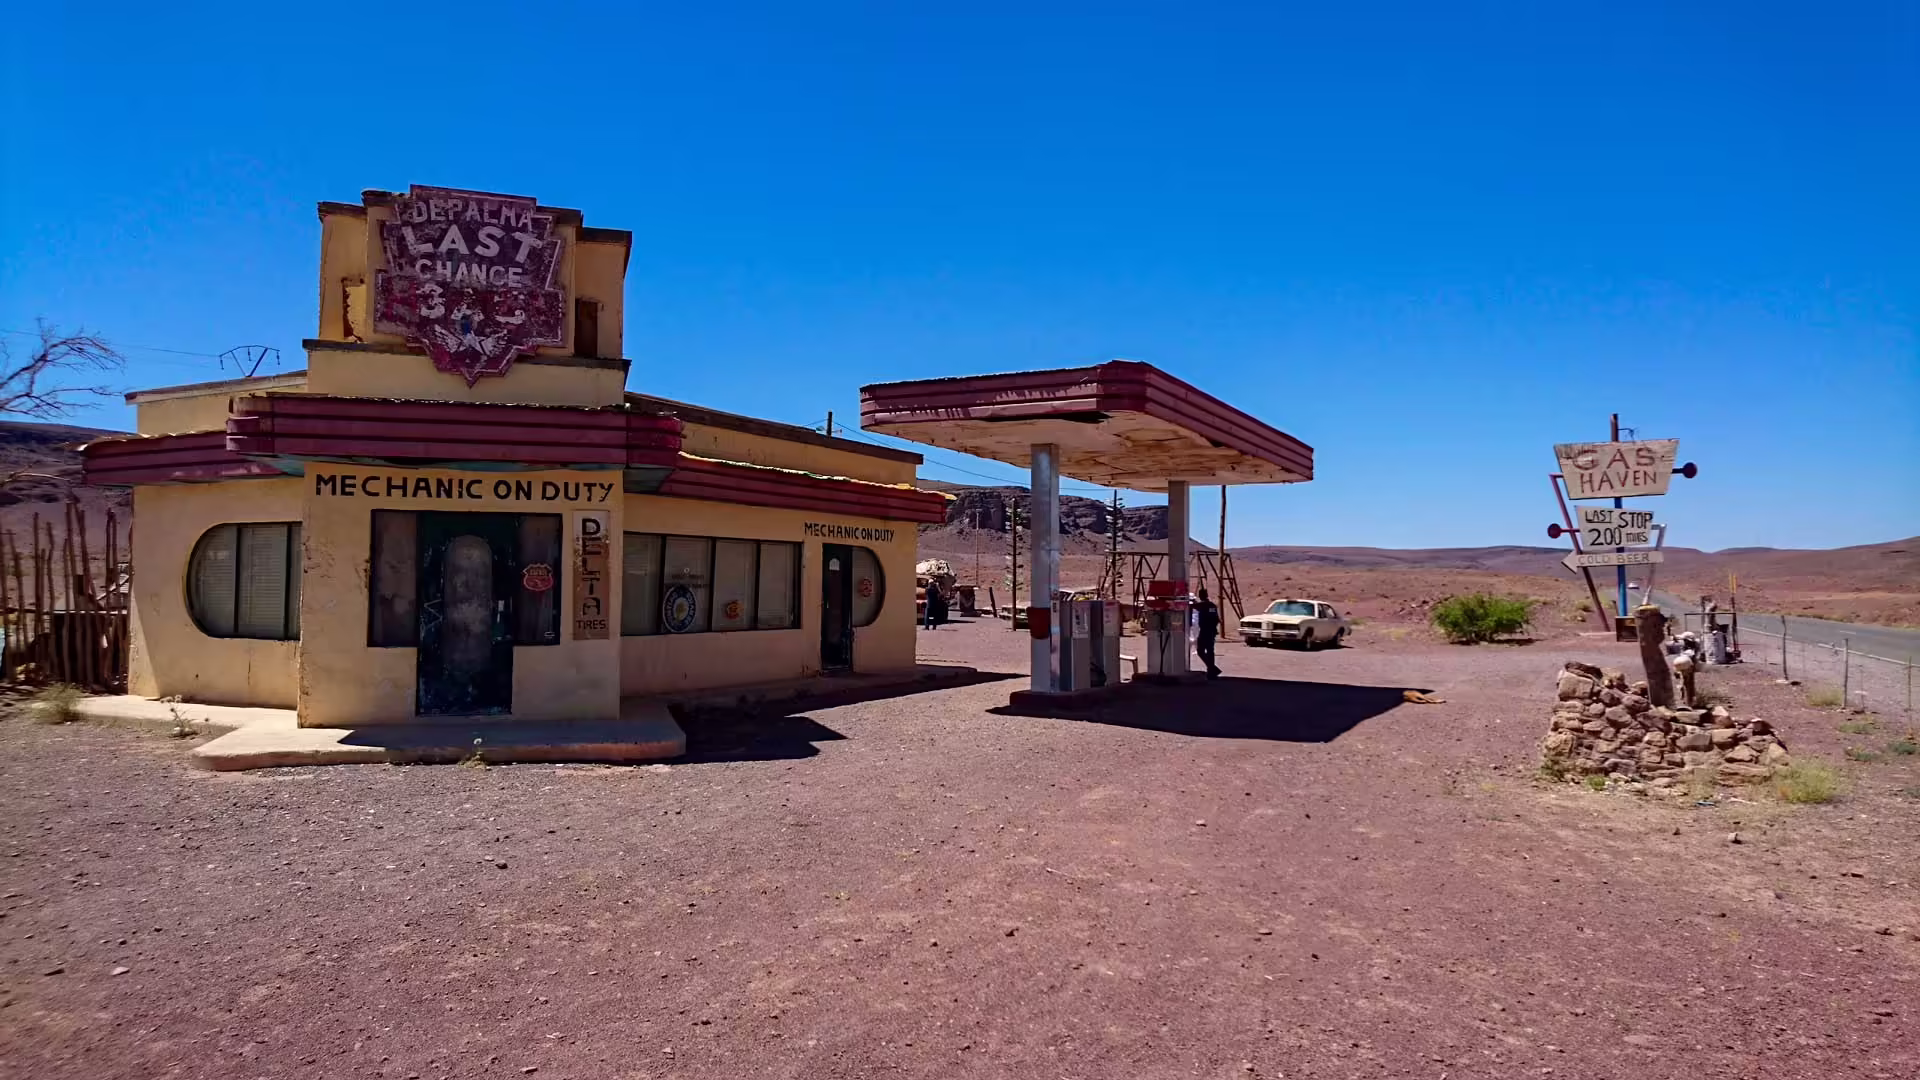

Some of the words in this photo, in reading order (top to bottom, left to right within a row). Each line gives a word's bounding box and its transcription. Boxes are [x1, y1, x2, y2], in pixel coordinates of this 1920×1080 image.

[412, 199, 534, 231] DEPALMA
[402, 224, 543, 263] LAST
[415, 258, 523, 288] CHANCE
[1573, 448, 1656, 471] GAS
[315, 474, 483, 499] MECHANIC
[493, 480, 533, 501] ON
[541, 481, 615, 502] DUTY
[1580, 470, 1656, 493] HAVEN
[1585, 510, 1614, 522] LAST
[1618, 511, 1653, 529] STOP
[804, 522, 859, 539] MECHANIC
[861, 527, 873, 540] ON
[874, 528, 895, 543] DUTY
[1588, 528, 1622, 546] 200
[581, 518, 601, 616] DELTA
[1578, 555, 1610, 565] COLD
[1617, 554, 1650, 564] BEER
[576, 619, 607, 630] TIRES
